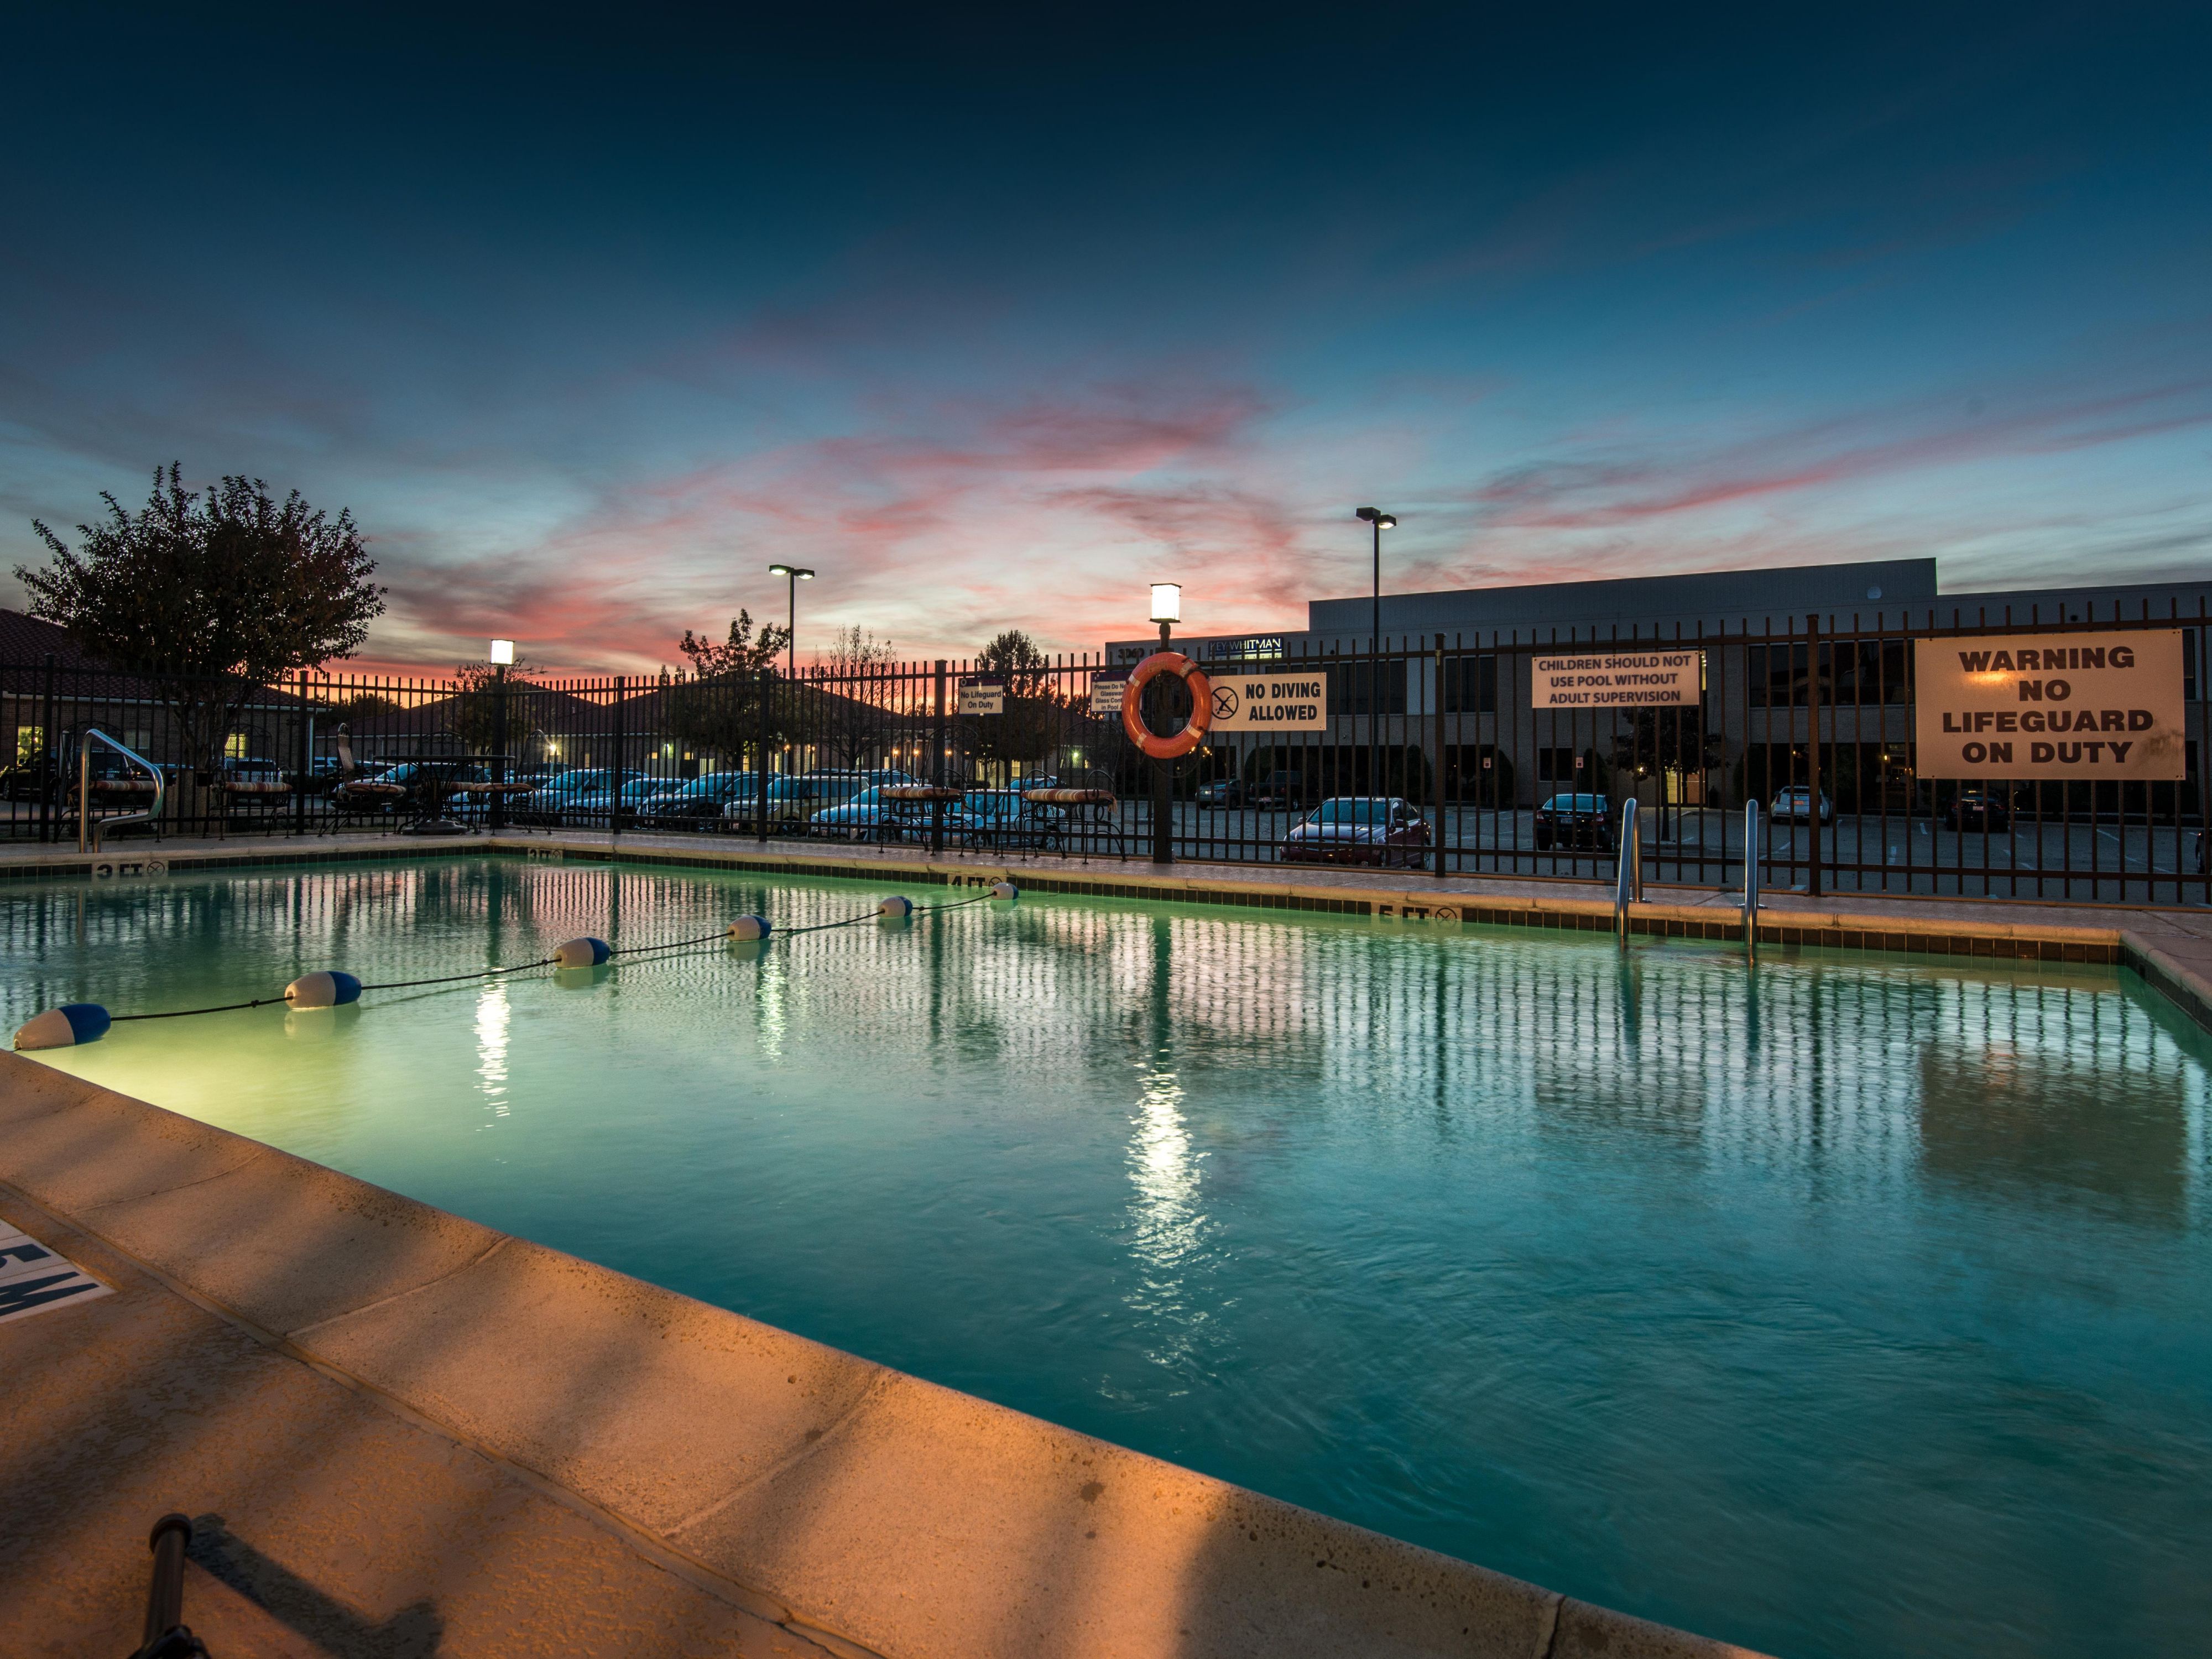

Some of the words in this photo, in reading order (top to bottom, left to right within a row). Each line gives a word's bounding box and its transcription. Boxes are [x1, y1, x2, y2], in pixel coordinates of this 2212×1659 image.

[1210, 641, 1227, 651] KEY
[1230, 638, 1281, 650] WHITMAN
[1538, 659, 1601, 671] CHILDREN
[1605, 656, 1659, 669] SHOULD
[1662, 655, 1691, 667] NOT
[1958, 646, 2135, 672] WARNING
[1551, 676, 1574, 687] USE
[1578, 675, 1612, 686] POOL
[1615, 673, 1678, 685] WITHOUT
[971, 690, 1001, 700] Lifeguard
[1246, 684, 1265, 699] NO
[1272, 682, 1321, 698] DIVING
[1550, 693, 1590, 704] ADULT
[1593, 691, 1681, 703] SUPERVISION
[2019, 679, 2071, 701] NO
[979, 701, 994, 709] Duty
[1249, 705, 1317, 721] ALLOWED
[1943, 709, 2154, 733] LIFEGUARD
[1961, 742, 2012, 763] ON
[2031, 742, 2134, 763] DUTY
